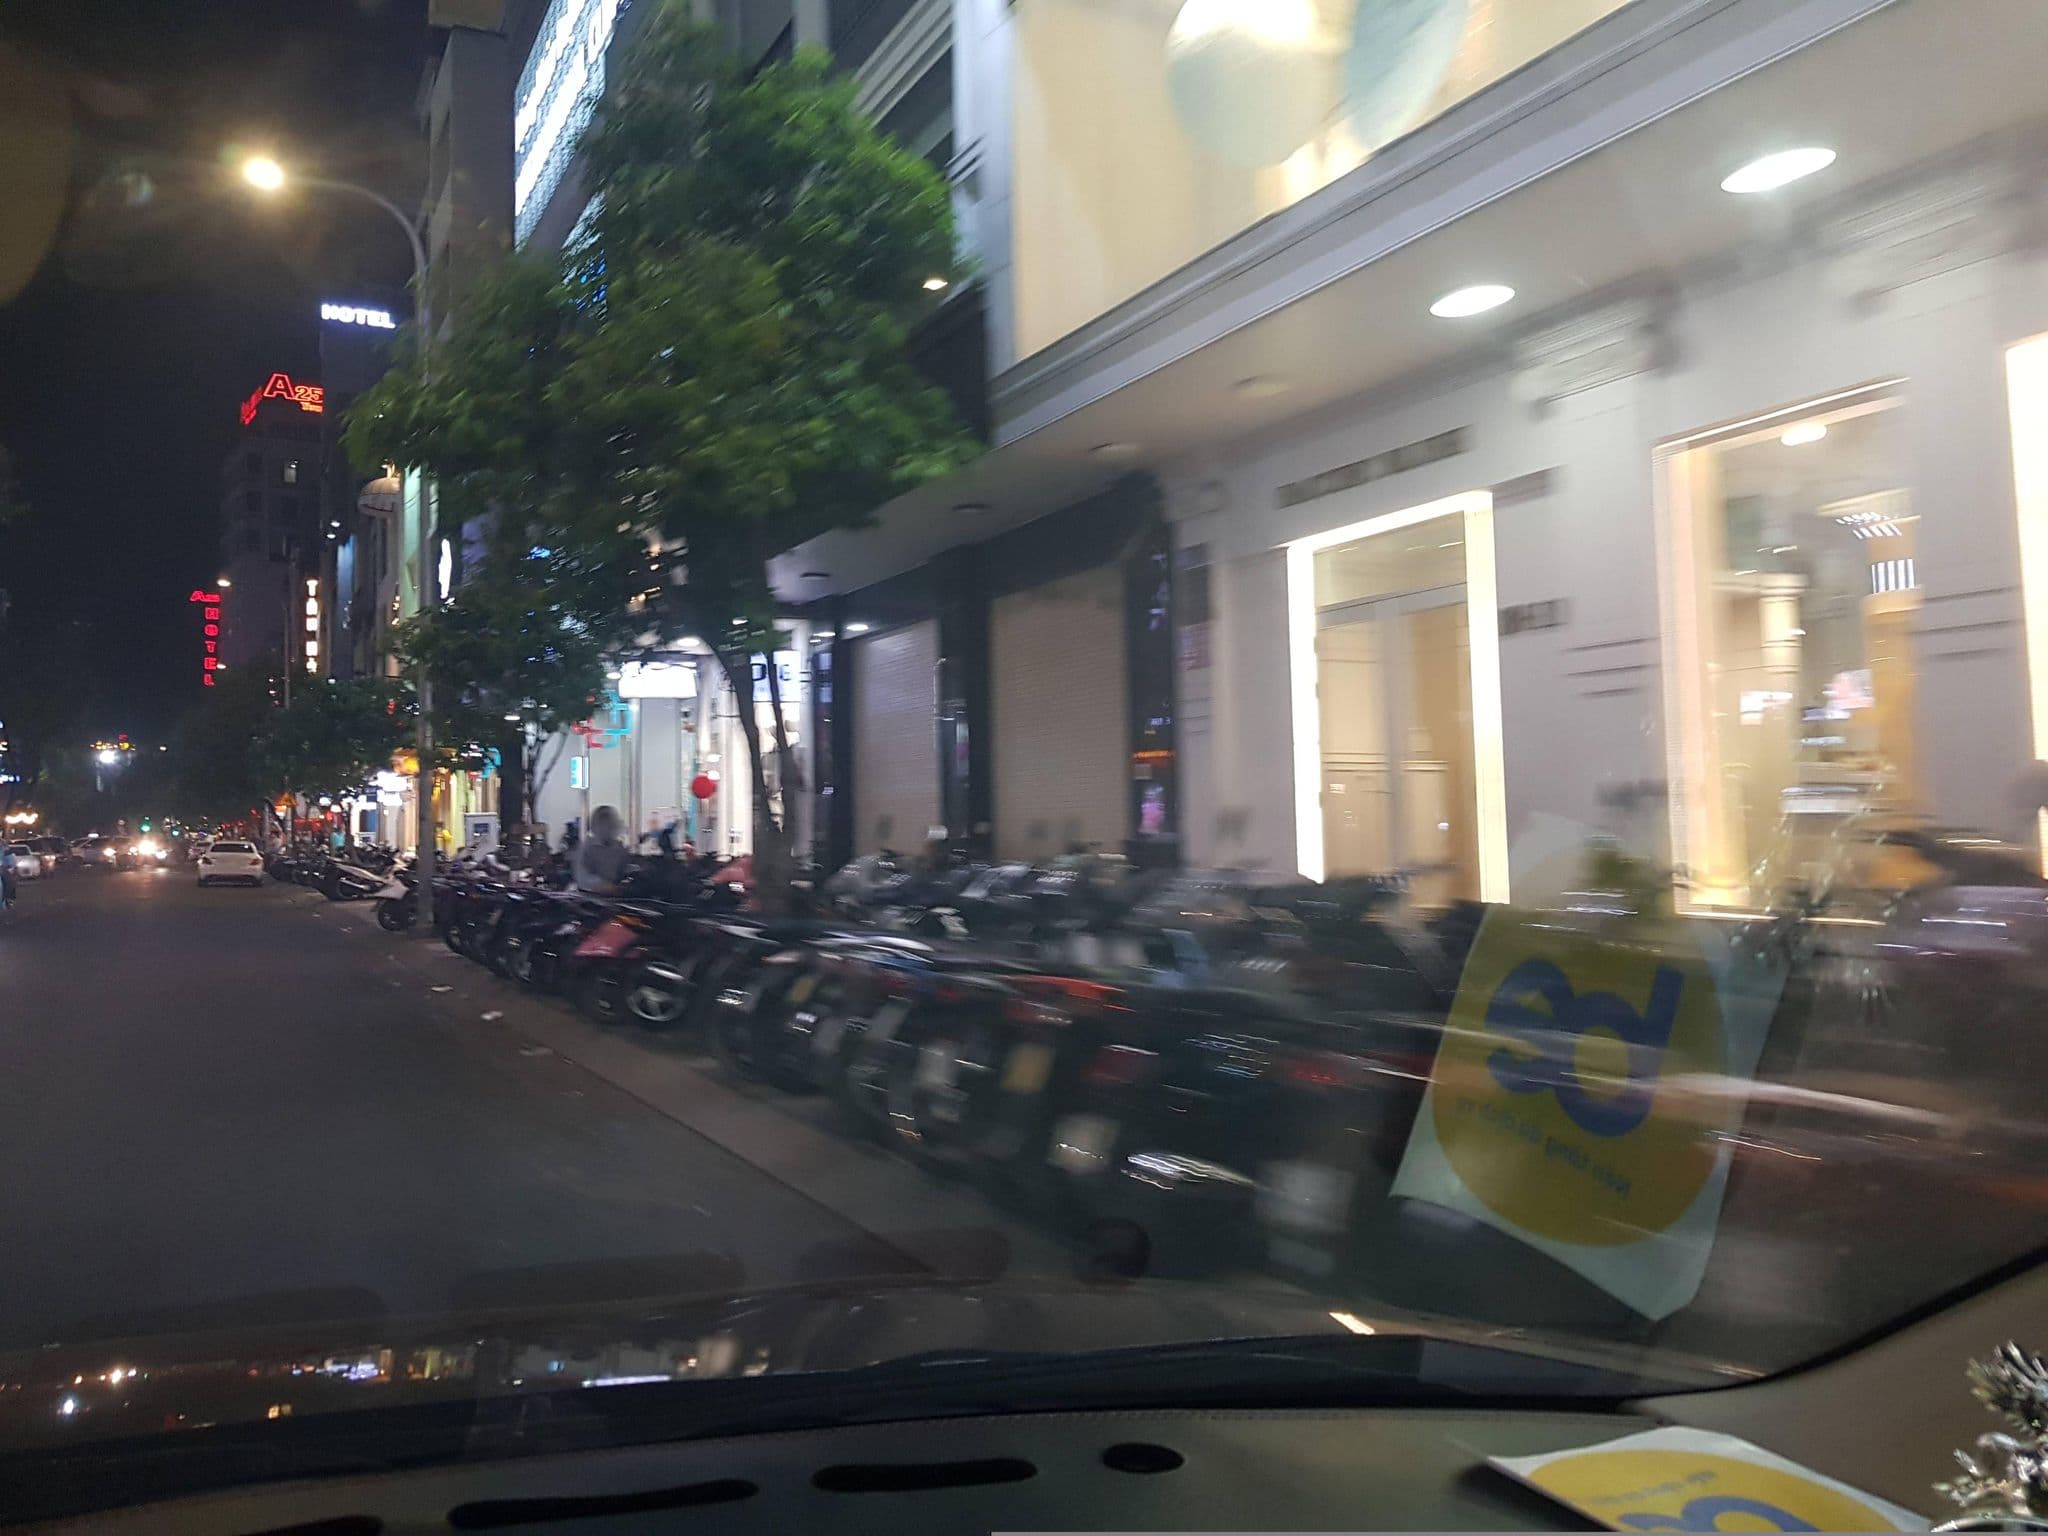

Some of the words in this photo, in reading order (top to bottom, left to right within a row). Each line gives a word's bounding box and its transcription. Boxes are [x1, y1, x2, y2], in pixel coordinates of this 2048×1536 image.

[320, 303, 396, 329] HOTEL
[262, 373, 324, 404] A25
[203, 606, 220, 687] HOTEL
